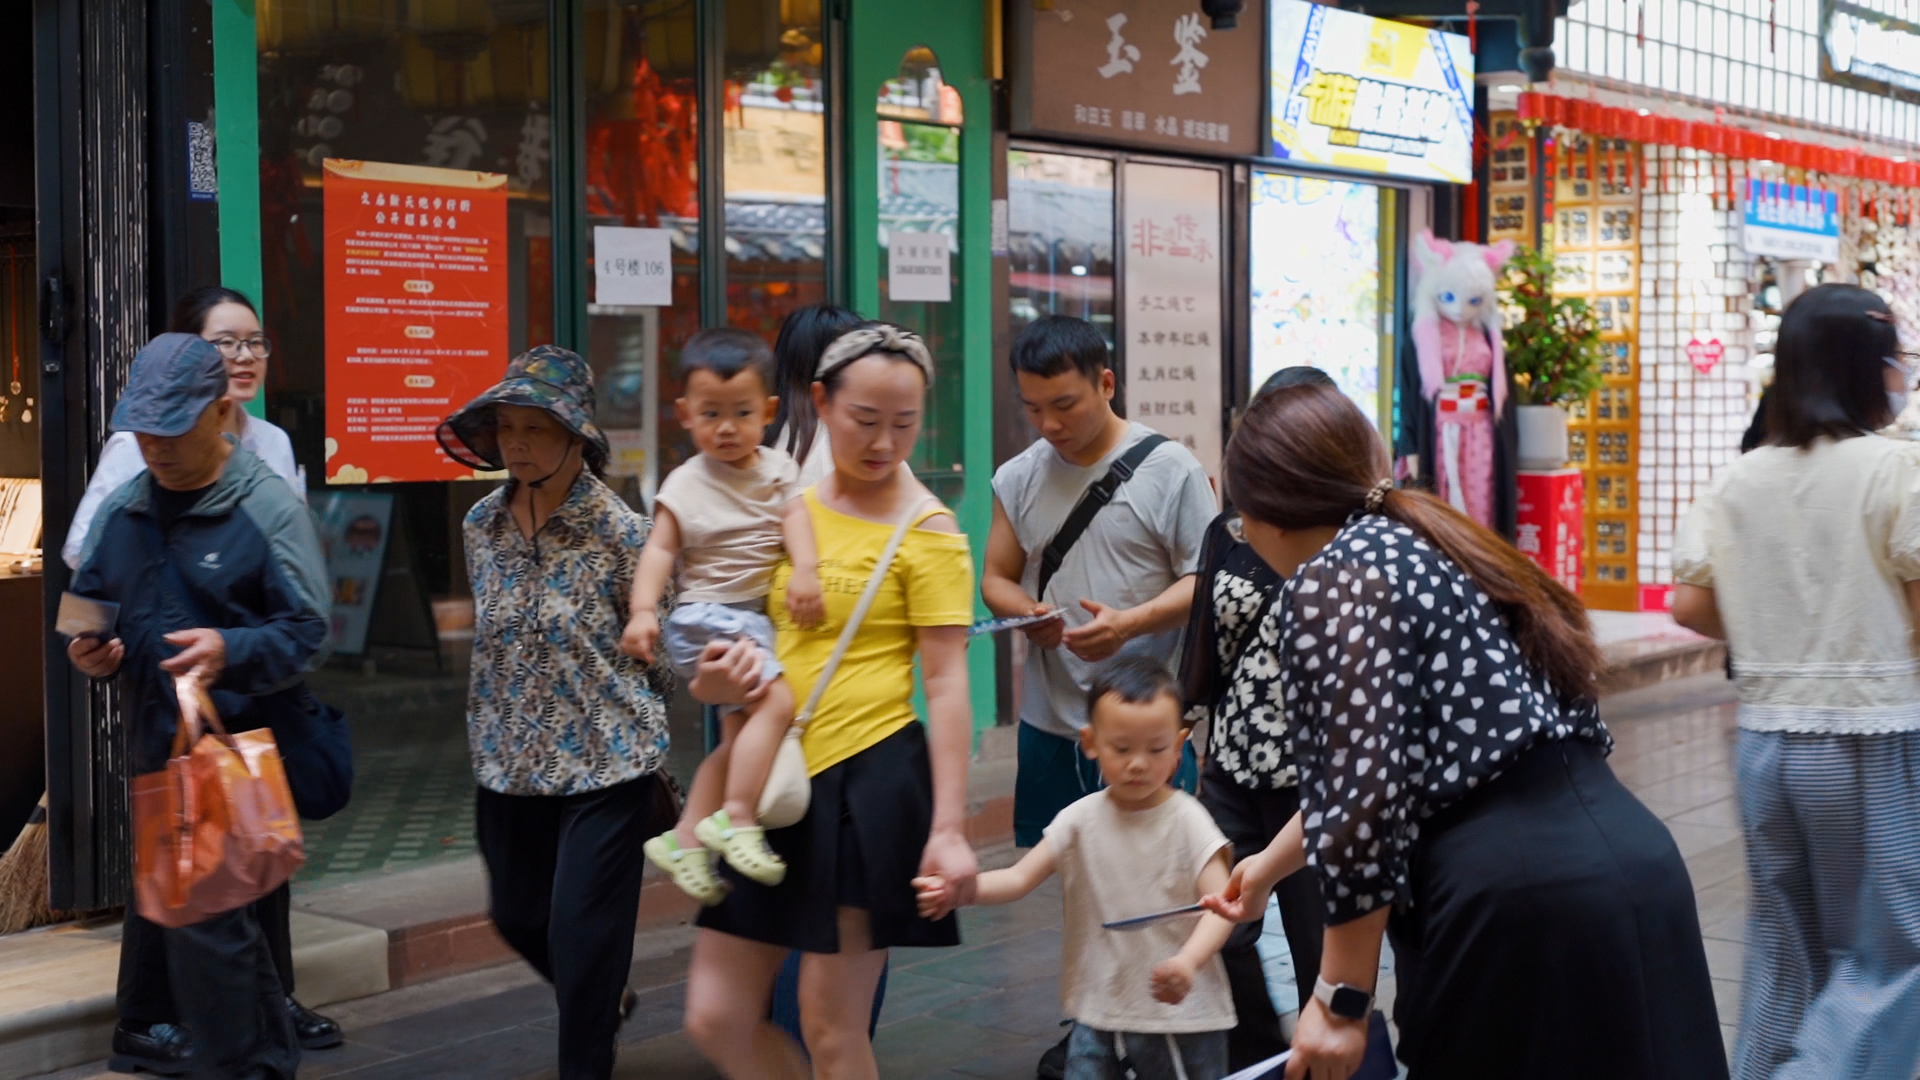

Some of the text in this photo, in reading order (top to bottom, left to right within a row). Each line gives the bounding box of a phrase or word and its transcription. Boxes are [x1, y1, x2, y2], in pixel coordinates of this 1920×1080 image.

[1074, 103, 1113, 128] 和田玉
[1154, 115, 1179, 137] 水晶
